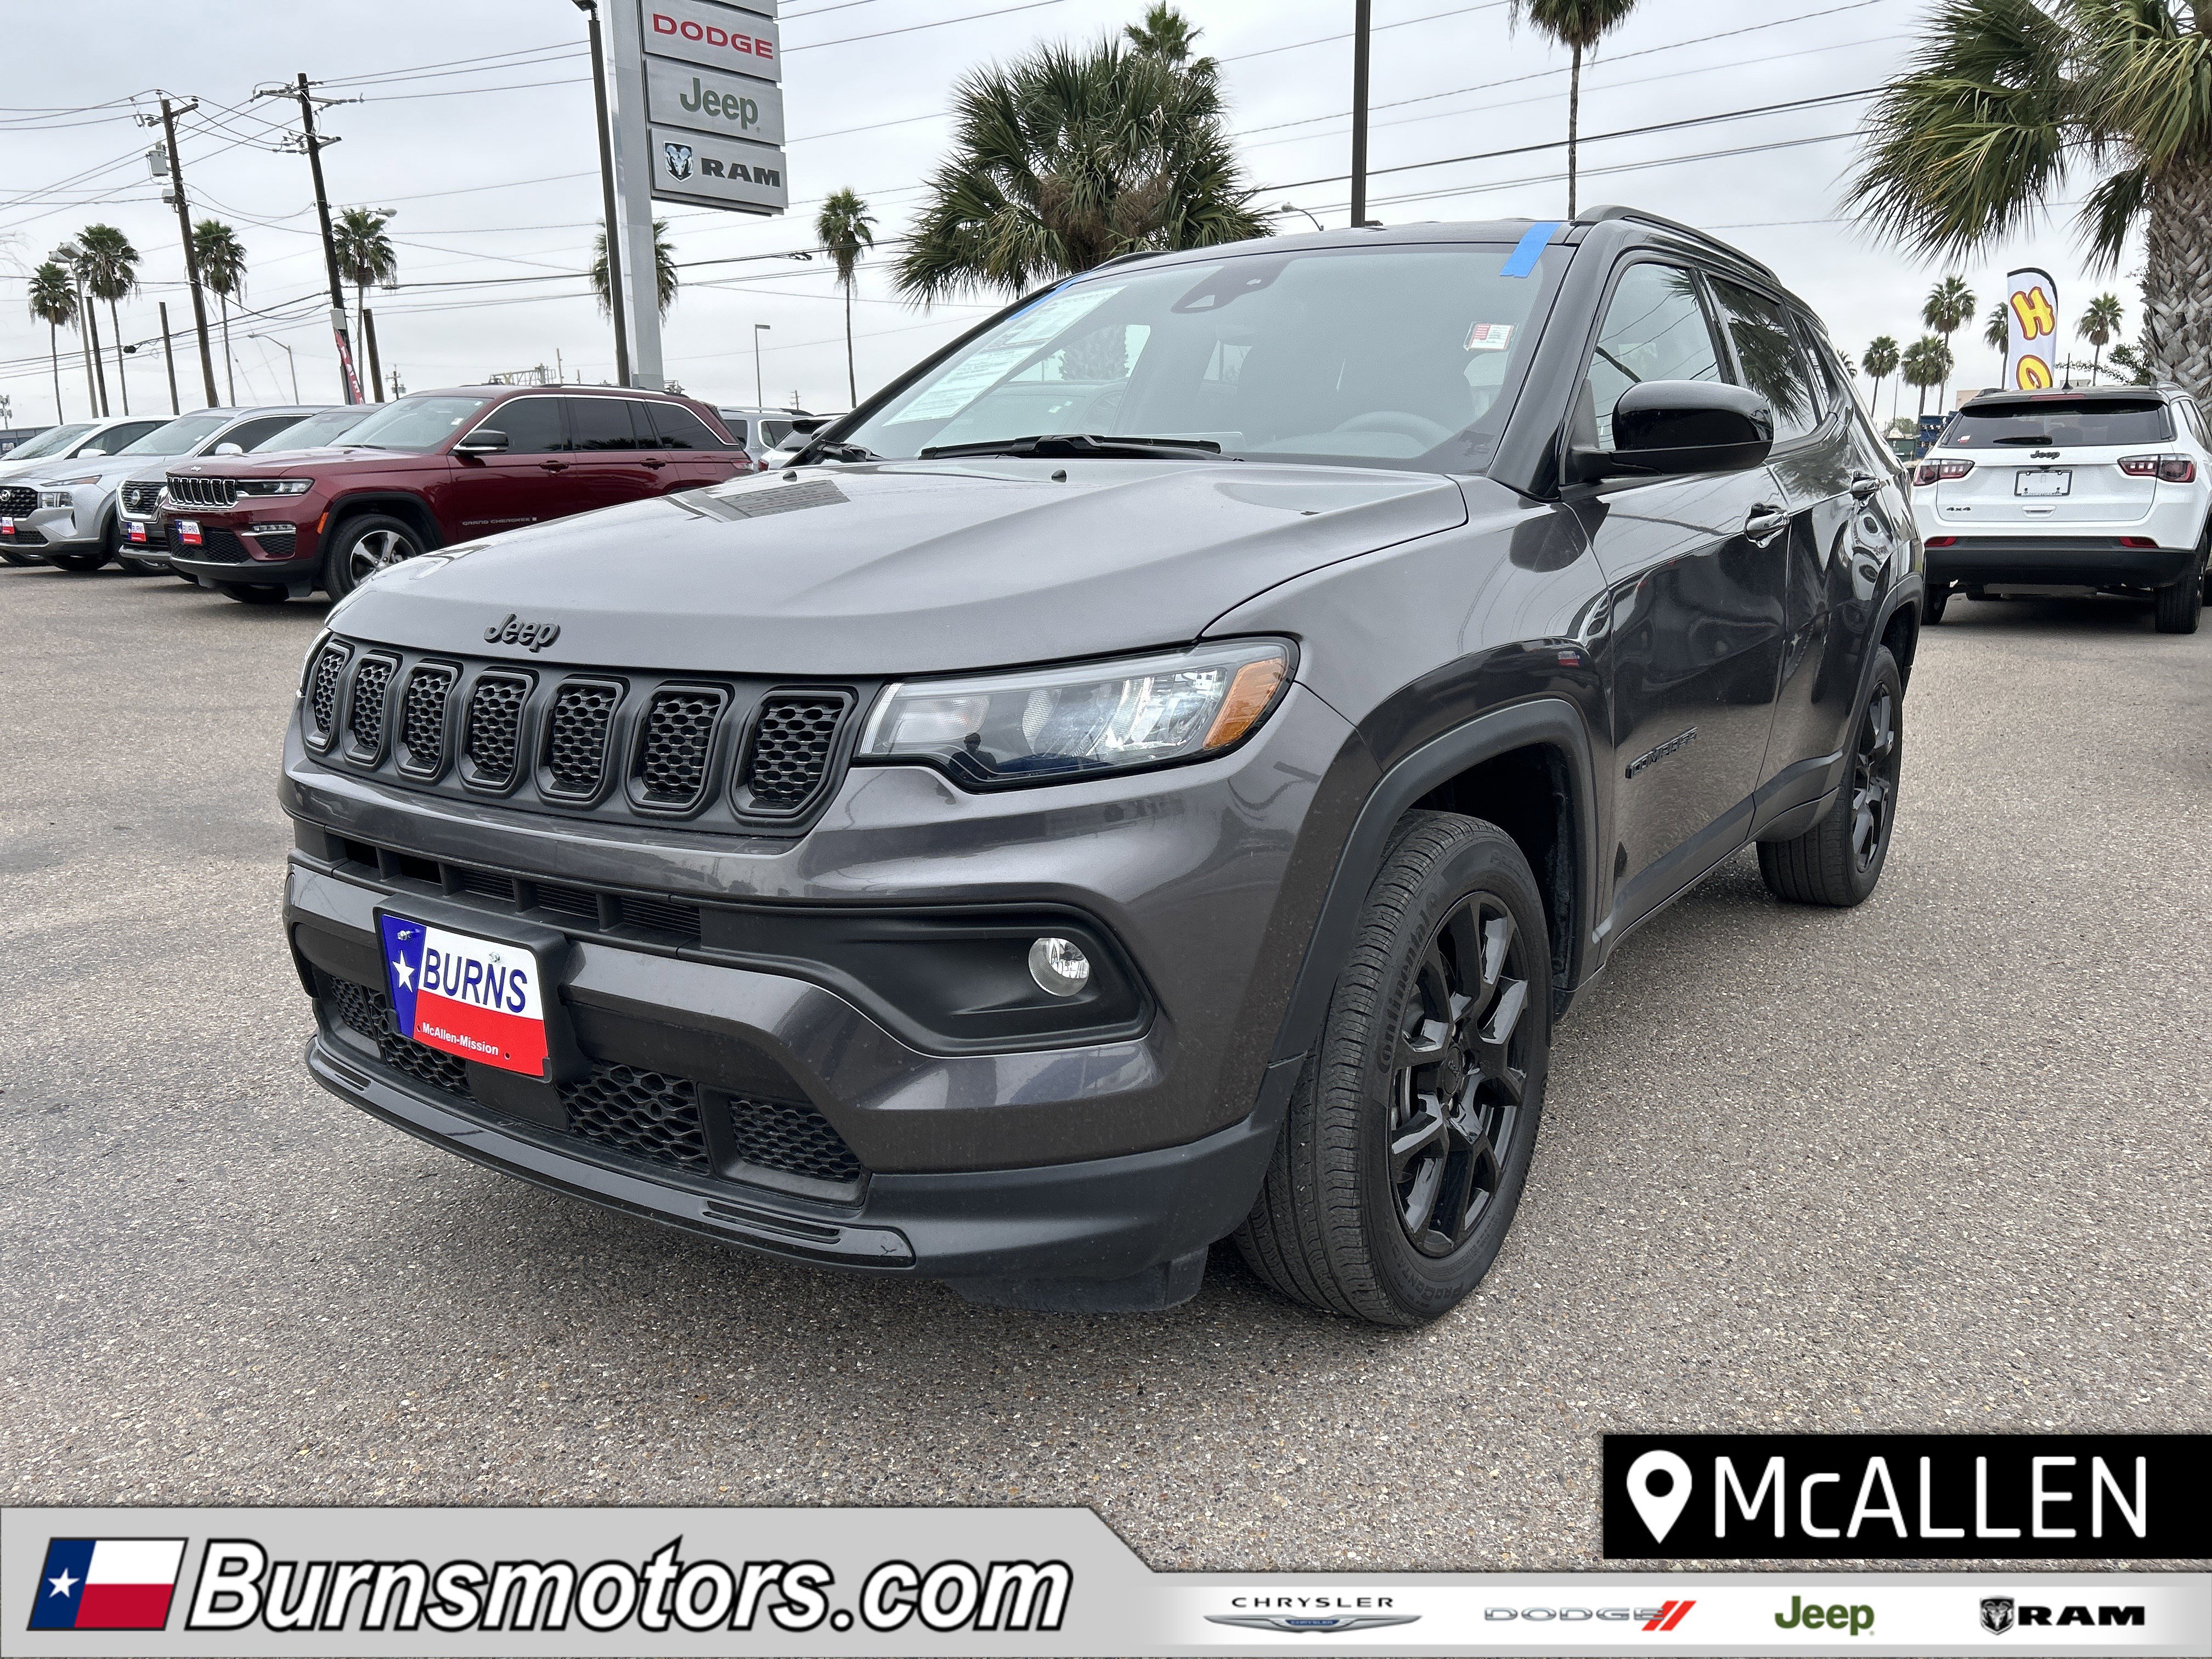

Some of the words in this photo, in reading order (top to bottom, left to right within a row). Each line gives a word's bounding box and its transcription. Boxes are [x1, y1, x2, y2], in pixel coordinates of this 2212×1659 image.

[653, 13, 774, 60] DODGE
[680, 77, 759, 130] Jeep
[701, 157, 781, 188] RAM
[2030, 450, 2061, 460] Jeep
[483, 613, 561, 653] Jeep
[423, 947, 528, 1013] BURNS
[422, 1022, 499, 1057] McAllen-Mission
